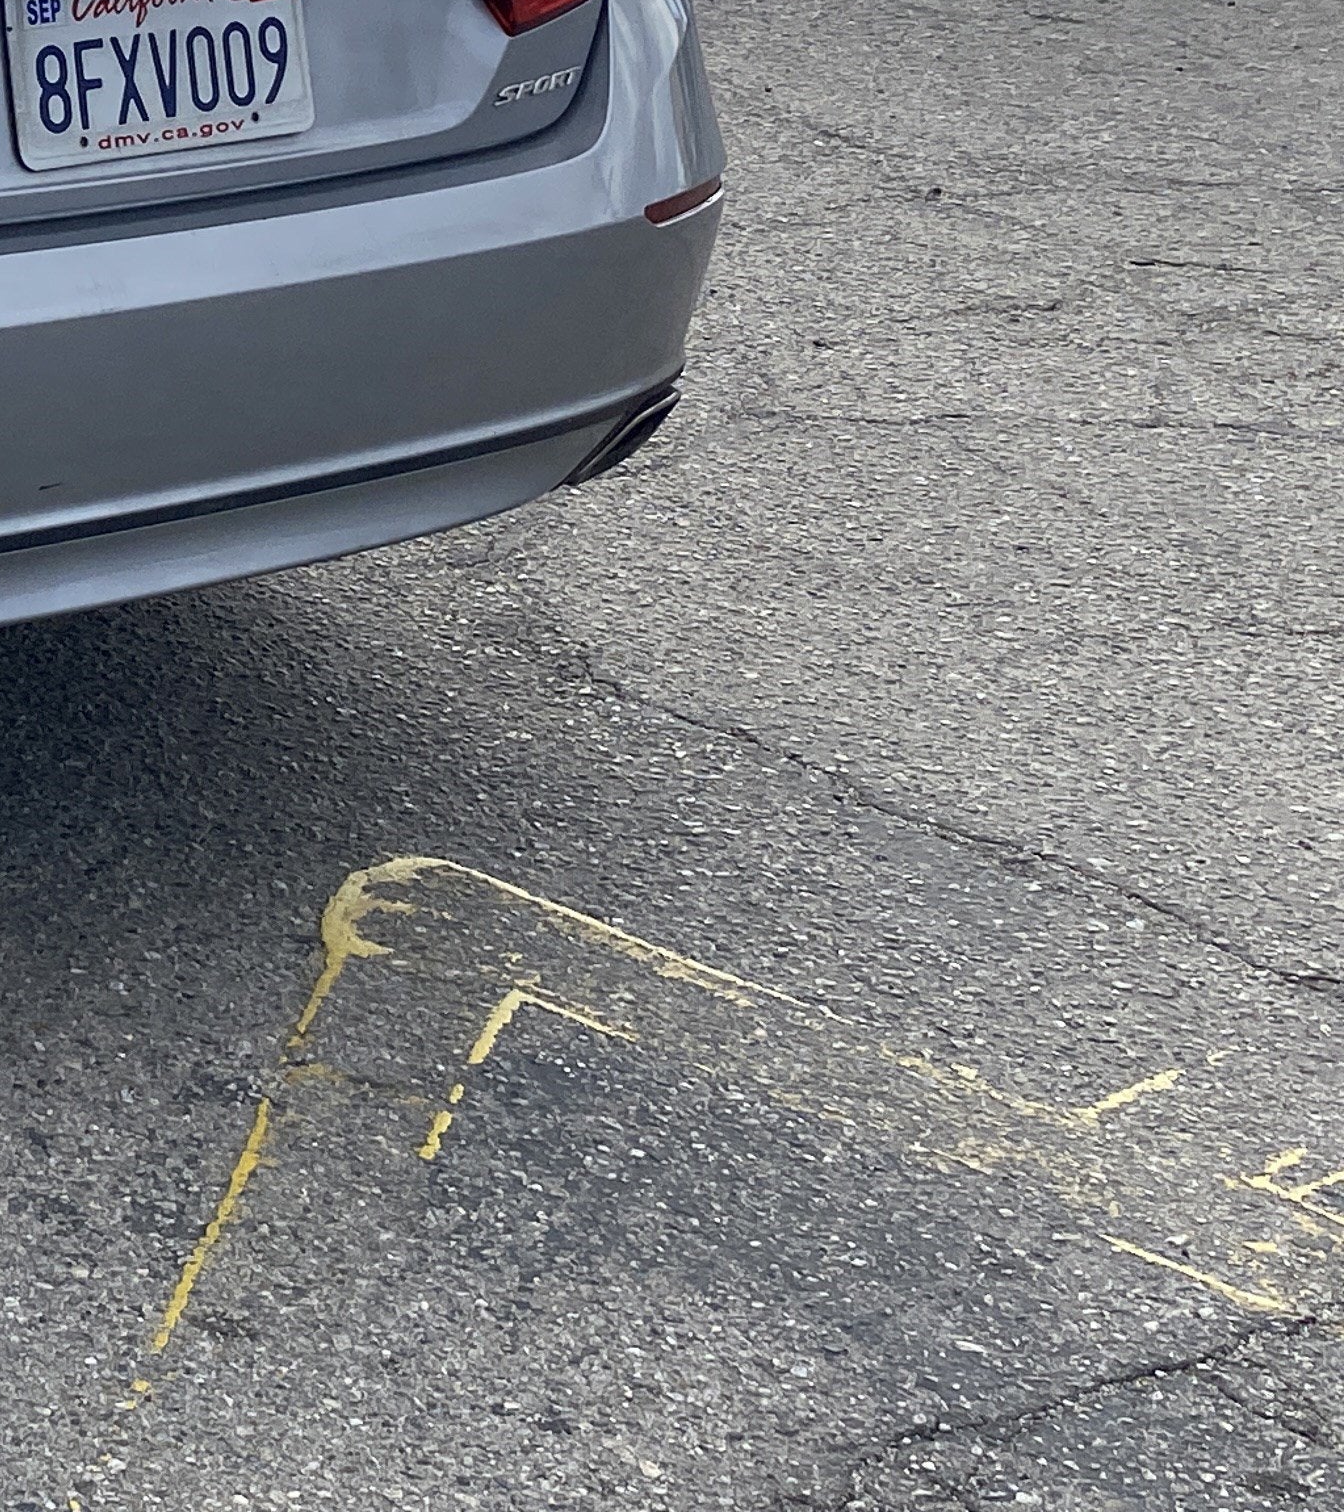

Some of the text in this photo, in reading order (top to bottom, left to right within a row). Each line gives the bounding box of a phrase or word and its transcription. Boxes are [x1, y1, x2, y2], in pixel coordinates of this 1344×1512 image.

[35, 16, 289, 135] 8FXV009
[493, 65, 582, 107] SPORT
[97, 118, 245, 150] dmv.ca.gov
